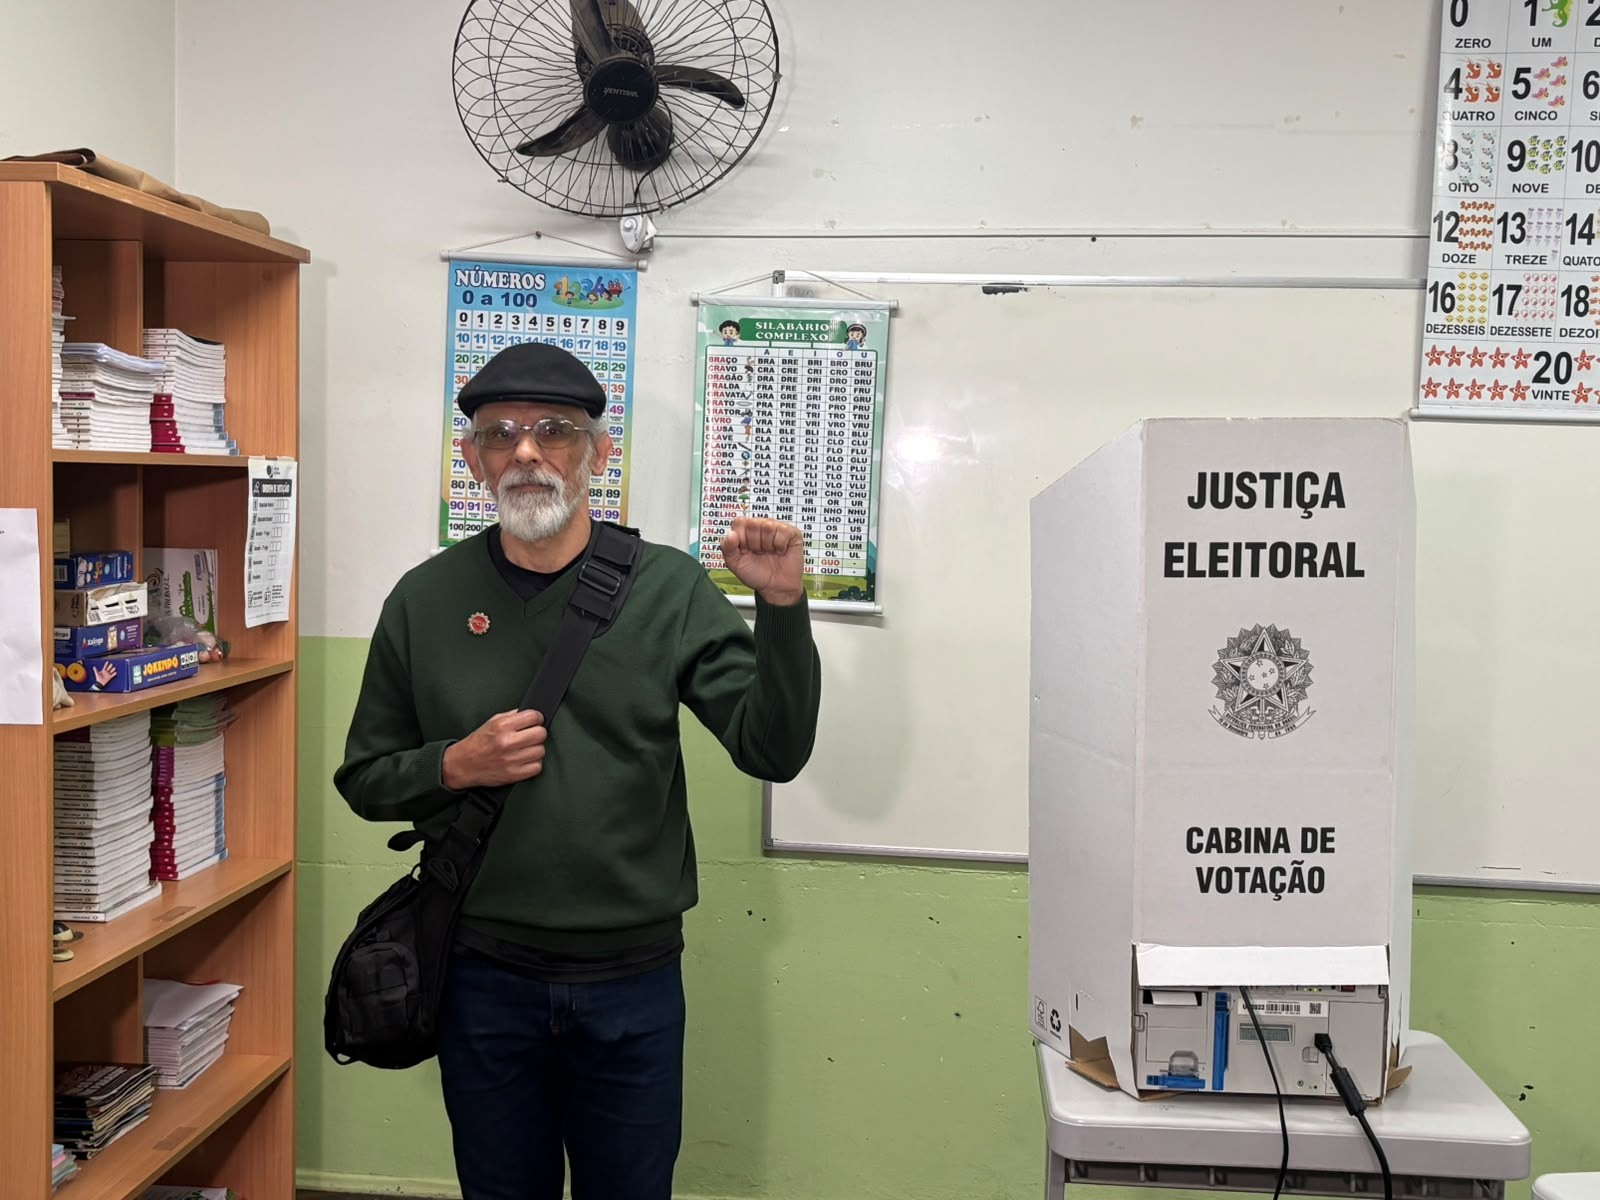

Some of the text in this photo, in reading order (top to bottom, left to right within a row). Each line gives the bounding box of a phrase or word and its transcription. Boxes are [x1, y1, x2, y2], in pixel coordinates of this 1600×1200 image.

[1450, 0, 1468, 27] 0
[1524, 0, 1538, 26] 1
[1455, 38, 1491, 49] ZERO
[1532, 37, 1551, 48] UM
[1443, 68, 1463, 100] 4
[1512, 67, 1531, 100] 5
[1583, 70, 1600, 100] 6
[1514, 111, 1558, 121] CINCO
[1506, 140, 1526, 173] 9
[1571, 139, 1600, 173] 10
[1449, 182, 1479, 193] OITO
[1512, 183, 1549, 193] NOVE
[1433, 210, 1459, 242] 12
[1496, 212, 1526, 244] 13
[1566, 213, 1595, 245] 14
[1442, 253, 1476, 264] DOZE
[1505, 254, 1548, 265] TREZE
[455, 265, 546, 291] NÚMEROS
[462, 290, 537, 308] 0 a 100
[1429, 281, 1456, 314] 16
[1492, 284, 1523, 316] 17
[1561, 284, 1589, 317] 18
[459, 312, 625, 331] 0 1 2 3 4 5 6 7 8 9
[755, 321, 829, 331] SILABÁRIO
[1426, 324, 1486, 335] DEZESSEIS
[755, 332, 828, 341] COMPLEXO
[1490, 326, 1552, 337] DEZESSETE
[456, 333, 469, 343] 10
[474, 334, 486, 344] 11
[491, 335, 504, 345] 12
[509, 336, 521, 344] 13
[561, 339, 573, 348] 16
[578, 340, 591, 349] 17
[595, 341, 608, 350] 18
[612, 341, 626, 351] 19
[455, 354, 469, 363] 20
[472, 355, 485, 364] 21
[594, 361, 608, 371] 28
[611, 363, 626, 372] 29
[1532, 351, 1572, 384] 20
[455, 375, 469, 384] 30
[610, 384, 625, 393] 39
[1532, 390, 1570, 401] VINTE
[609, 405, 624, 414] 49
[453, 417, 623, 436] 50 59
[452, 459, 621, 478] 70 79
[451, 480, 465, 489] 80
[468, 481, 481, 490] 81
[589, 488, 602, 497] 88
[606, 489, 620, 498] 89
[1187, 471, 1346, 519] JUSTIÇA
[450, 501, 464, 510] 90
[467, 502, 480, 511] 91
[485, 503, 498, 512] 92
[605, 510, 620, 519] 99
[449, 523, 464, 531] 100
[1164, 541, 1365, 578] ELEITORAL
[1186, 826, 1335, 854] CABINA DE
[1195, 859, 1325, 901] VOTAÇÃO
